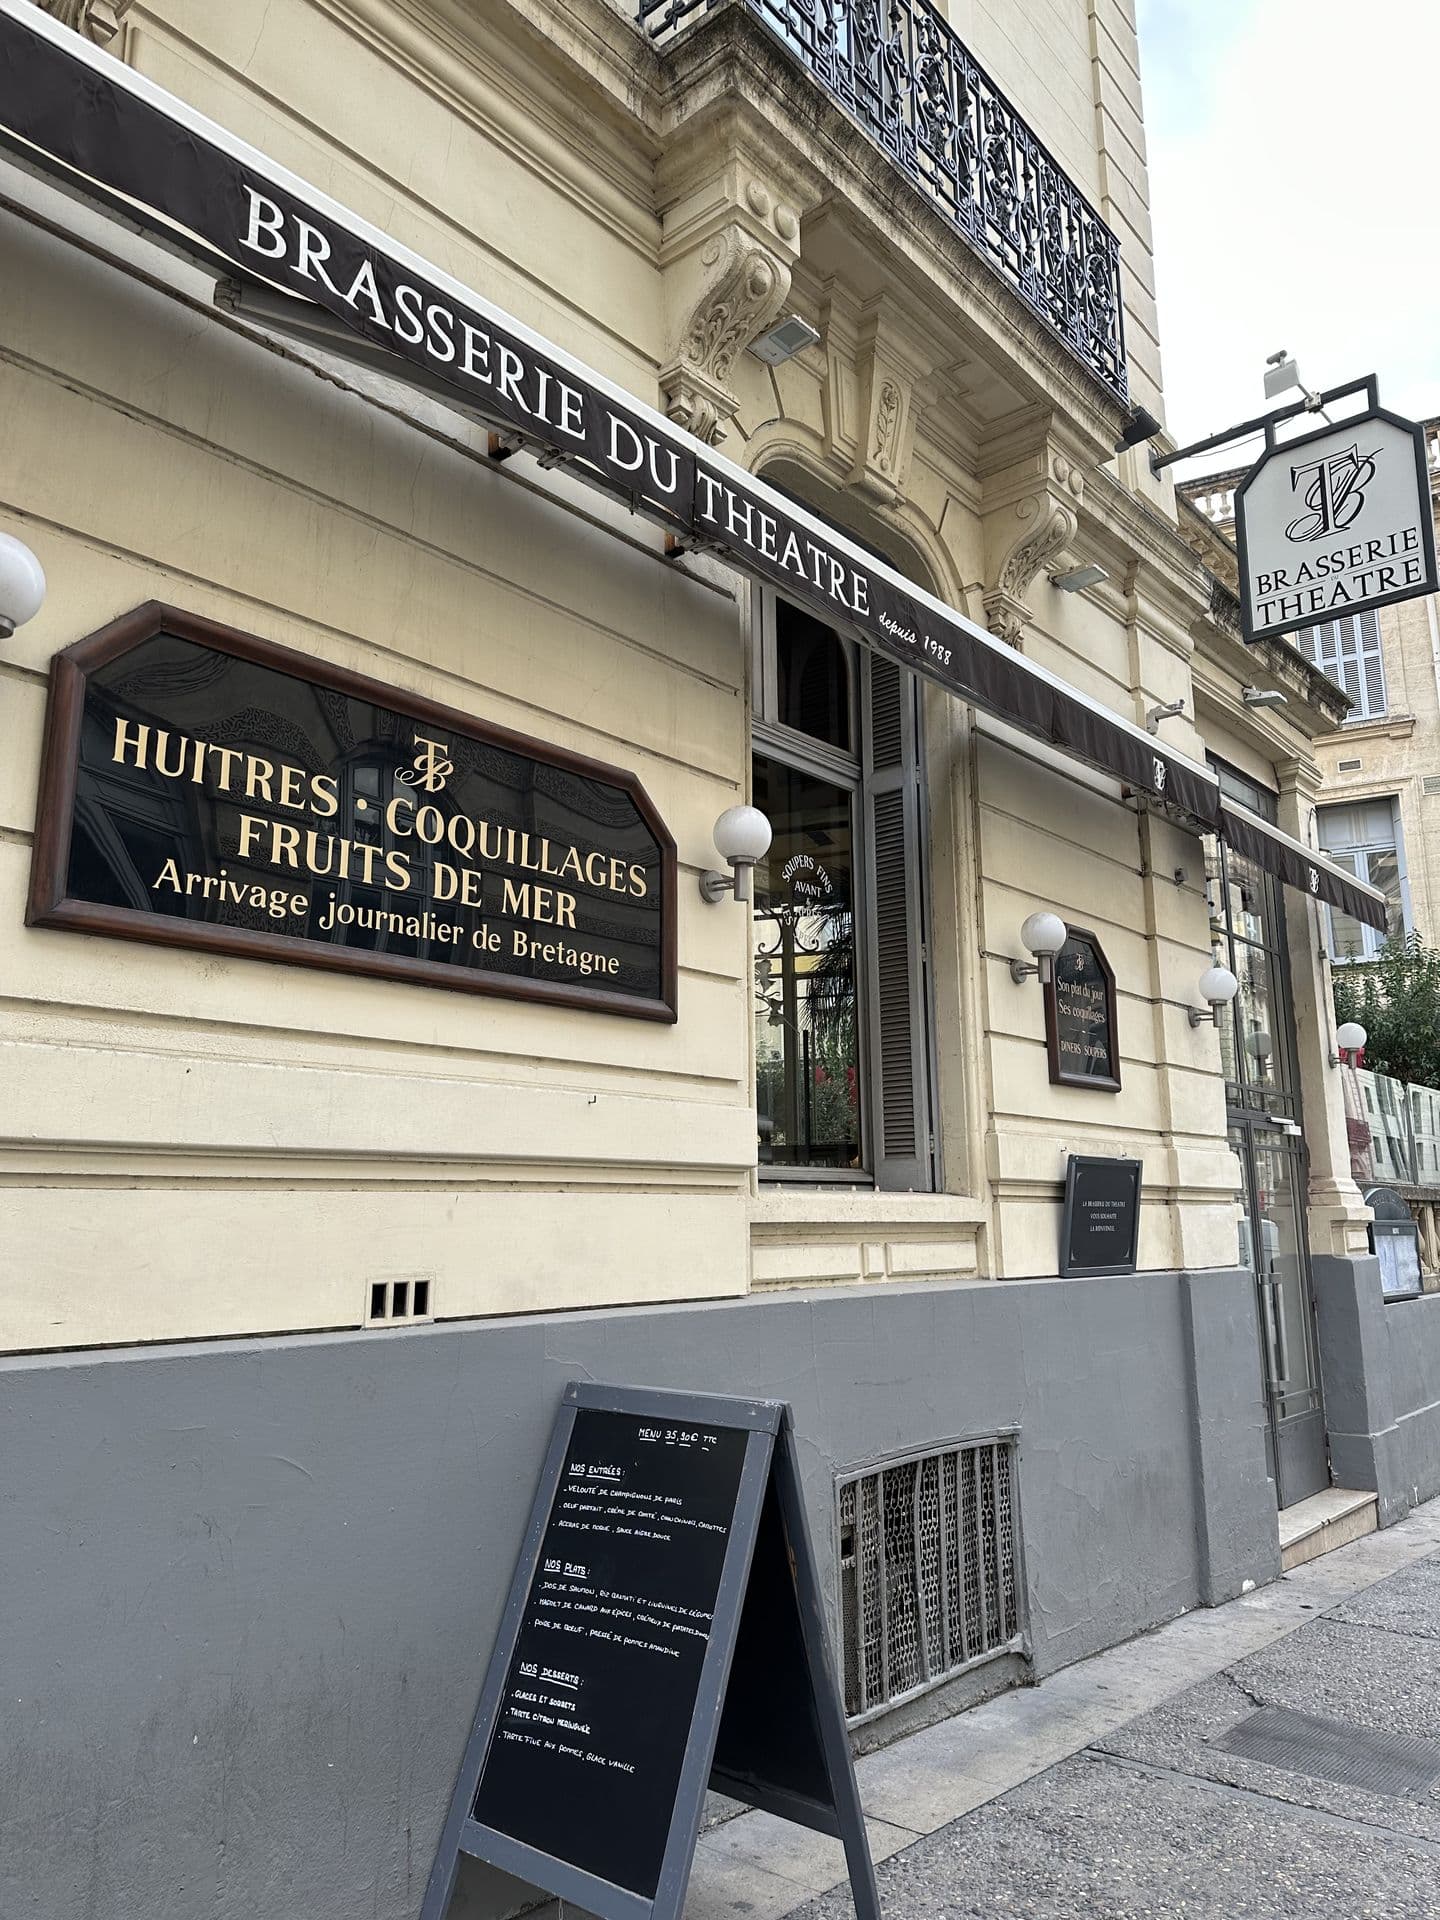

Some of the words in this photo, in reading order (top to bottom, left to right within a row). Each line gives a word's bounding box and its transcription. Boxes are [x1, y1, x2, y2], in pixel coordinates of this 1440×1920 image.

[239, 184, 586, 440] BRASSERIE
[607, 411, 681, 494] DU
[696, 468, 870, 617] THEATRE
[1256, 527, 1419, 596] BRASSERIE
[1257, 557, 1422, 626] THEATRE
[879, 611, 917, 645] depuis
[924, 635, 952, 666] 1988
[112, 717, 338, 817] HUITRES
[386, 797, 648, 898] COQUILLAGES
[238, 815, 411, 891] FRUITS
[434, 863, 483, 908] DE
[502, 882, 577, 929] MER
[782, 854, 815, 883] SOUPERS
[816, 865, 833, 893] FINS
[794, 880, 822, 897] AVANT
[152, 858, 309, 918] Arrivage
[319, 893, 464, 946] journalier
[473, 923, 501, 952] de
[512, 930, 620, 976] Bretagne
[1057, 976, 1069, 992] Son
[1070, 980, 1082, 998] plat
[1082, 983, 1090, 997] du
[1091, 985, 1103, 1003] jour
[1059, 999, 1071, 1016] Ses
[639, 1428, 661, 1439] MENU
[704, 1435, 717, 1444] TTC
[571, 1463, 586, 1473] NOS
[558, 1520, 580, 1528] ACCRAS
[616, 1527, 632, 1535] SAUCE
[634, 1529, 651, 1538] AIGRE
[652, 1532, 671, 1541] DOUCE
[698, 1521, 727, 1534] CAROTTES
[545, 1558, 561, 1569] NOS
[539, 1599, 562, 1607] MAGRET
[574, 1603, 598, 1612] CANARD
[541, 1581, 558, 1590] DOS
[678, 1607, 688, 1615] DE
[613, 1634, 622, 1642] DE
[624, 1637, 648, 1645] POMMES
[520, 1661, 538, 1673] NOS
[514, 1689, 536, 1702] GLACES
[539, 1695, 548, 1703] ET
[548, 1697, 576, 1711] SORBETS
[510, 1707, 531, 1719] TARTE
[532, 1713, 554, 1725] CITRON
[503, 1730, 523, 1741] TARTE
[524, 1735, 541, 1747] FINE
[544, 1740, 556, 1749] AUX
[586, 1752, 606, 1765] GLACE
[608, 1759, 635, 1774] VANILLE
